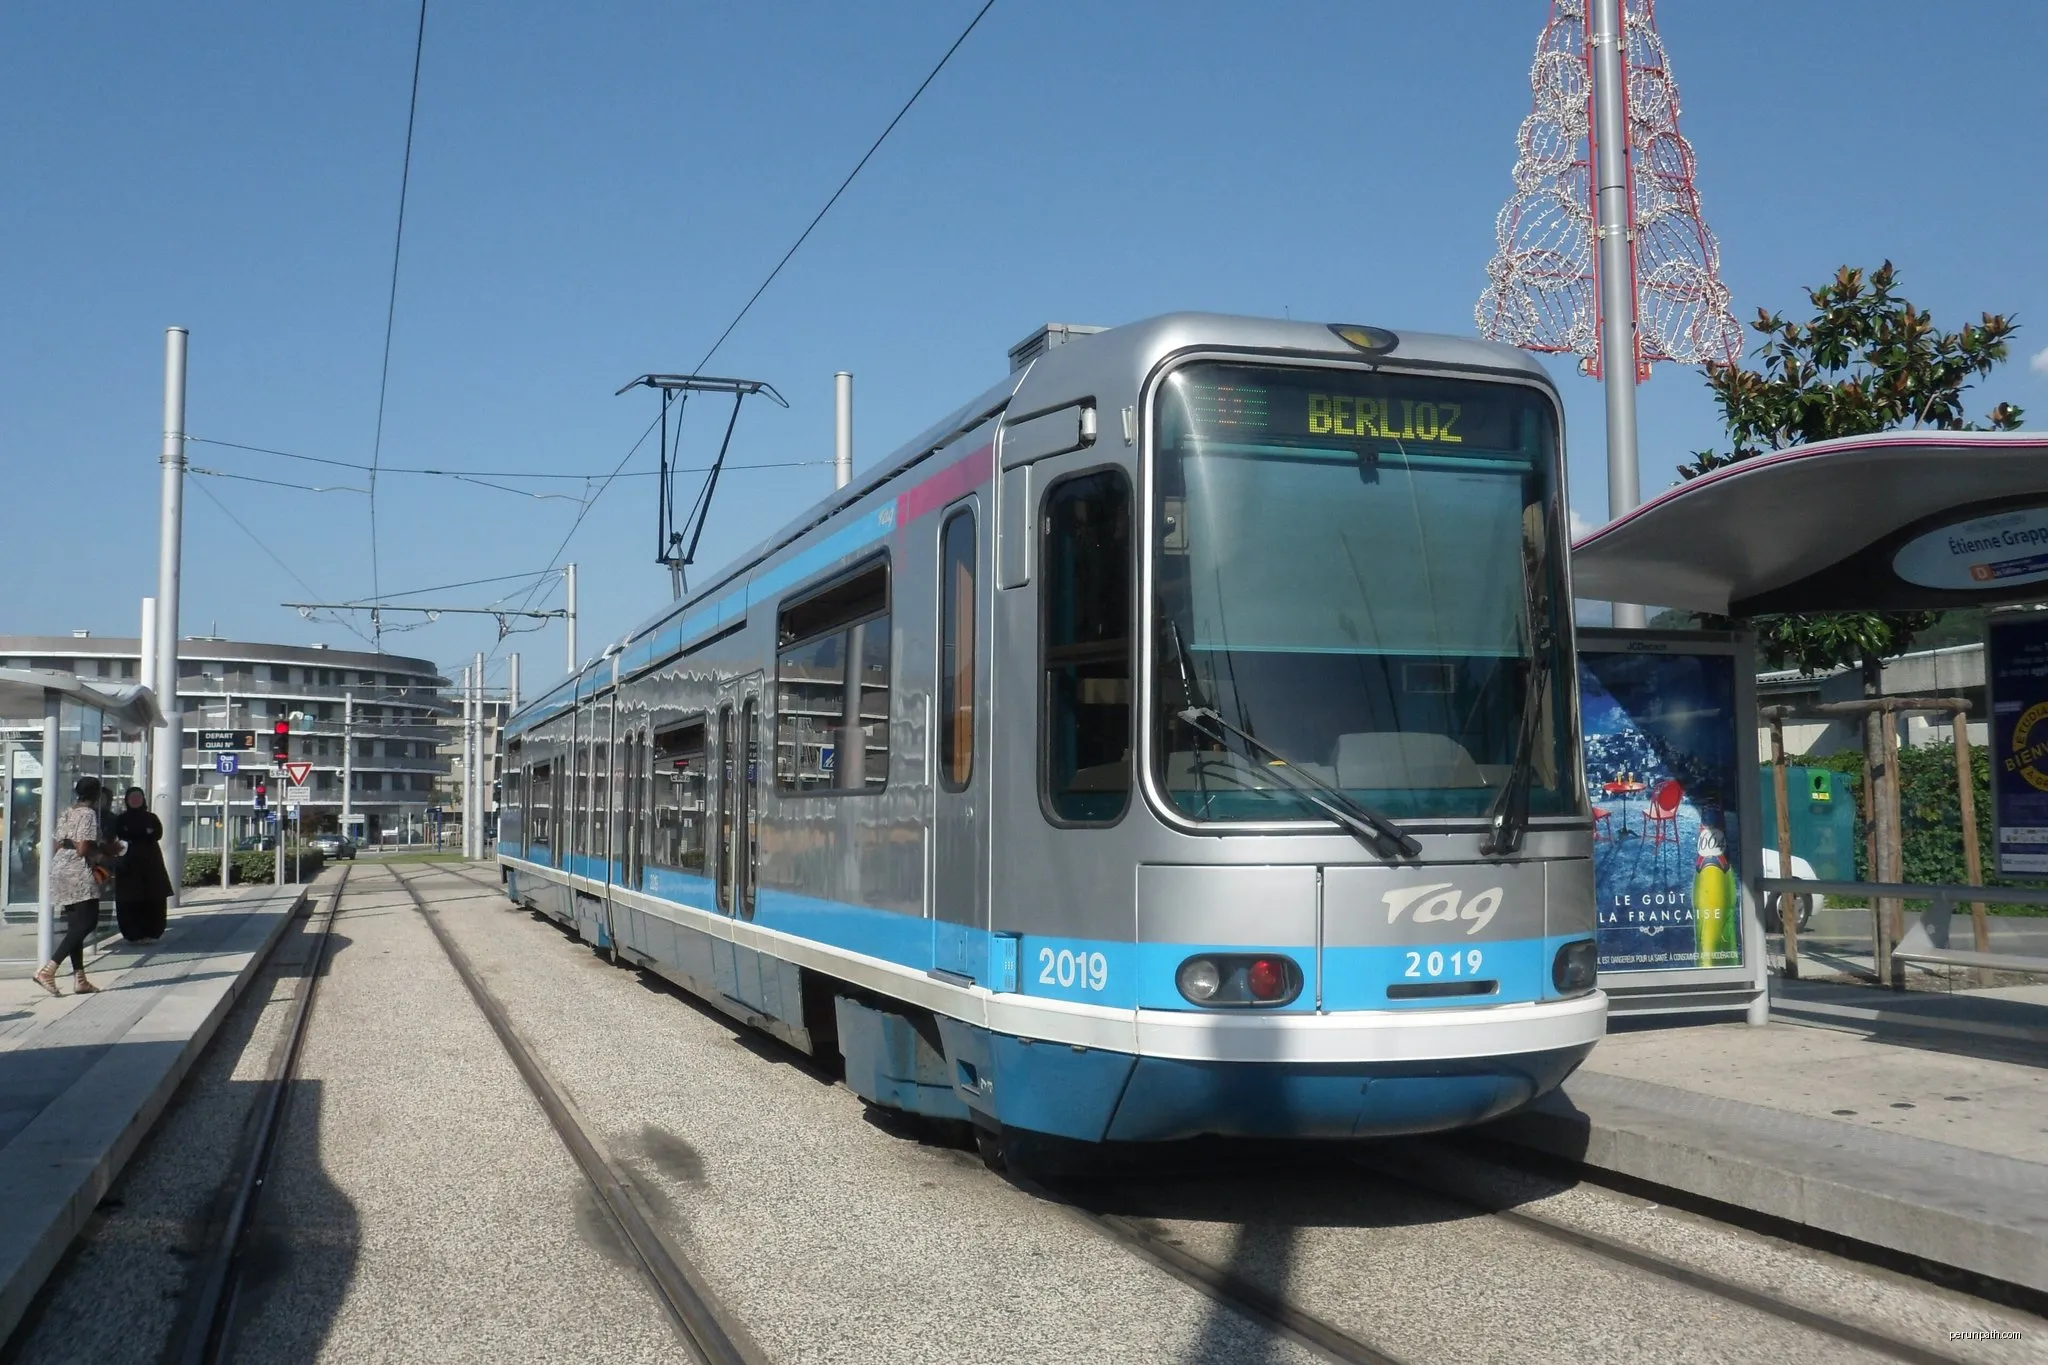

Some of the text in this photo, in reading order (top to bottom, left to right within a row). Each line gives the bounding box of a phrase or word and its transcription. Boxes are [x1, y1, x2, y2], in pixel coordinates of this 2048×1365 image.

[1308, 393, 1462, 443] BERLIOZ
[1948, 537, 2001, 555] Étienne
[1615, 891, 1685, 906] LE GOÛT
[1599, 908, 1721, 923] LA FRANÇAISE
[1038, 948, 1108, 991] 2019
[1405, 950, 1483, 978] 2019
